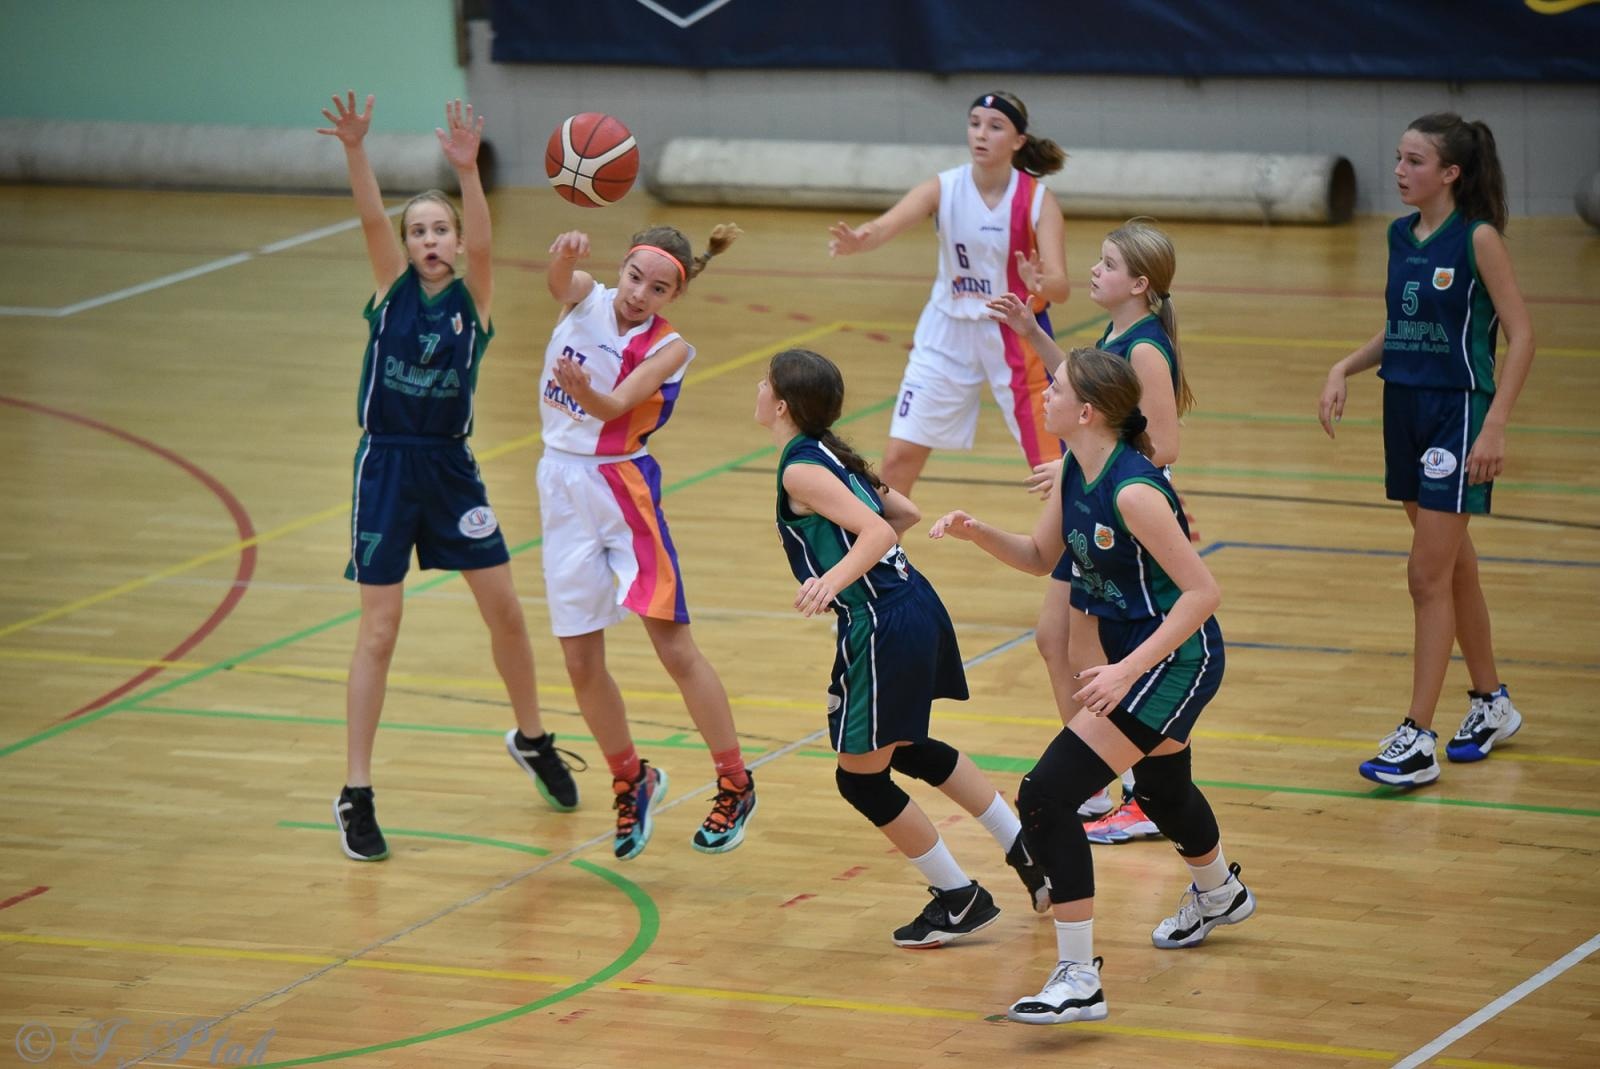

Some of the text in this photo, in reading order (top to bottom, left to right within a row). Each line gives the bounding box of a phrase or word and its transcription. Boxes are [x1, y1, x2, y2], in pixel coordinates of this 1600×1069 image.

[955, 243, 970, 270] 6
[952, 276, 992, 295] MINI
[1401, 281, 1420, 316] 5
[1385, 319, 1449, 342] LIMPIA
[419, 333, 440, 364] 7
[543, 379, 586, 415] MIN
[899, 390, 913, 417] 6
[359, 531, 383, 567] 7
